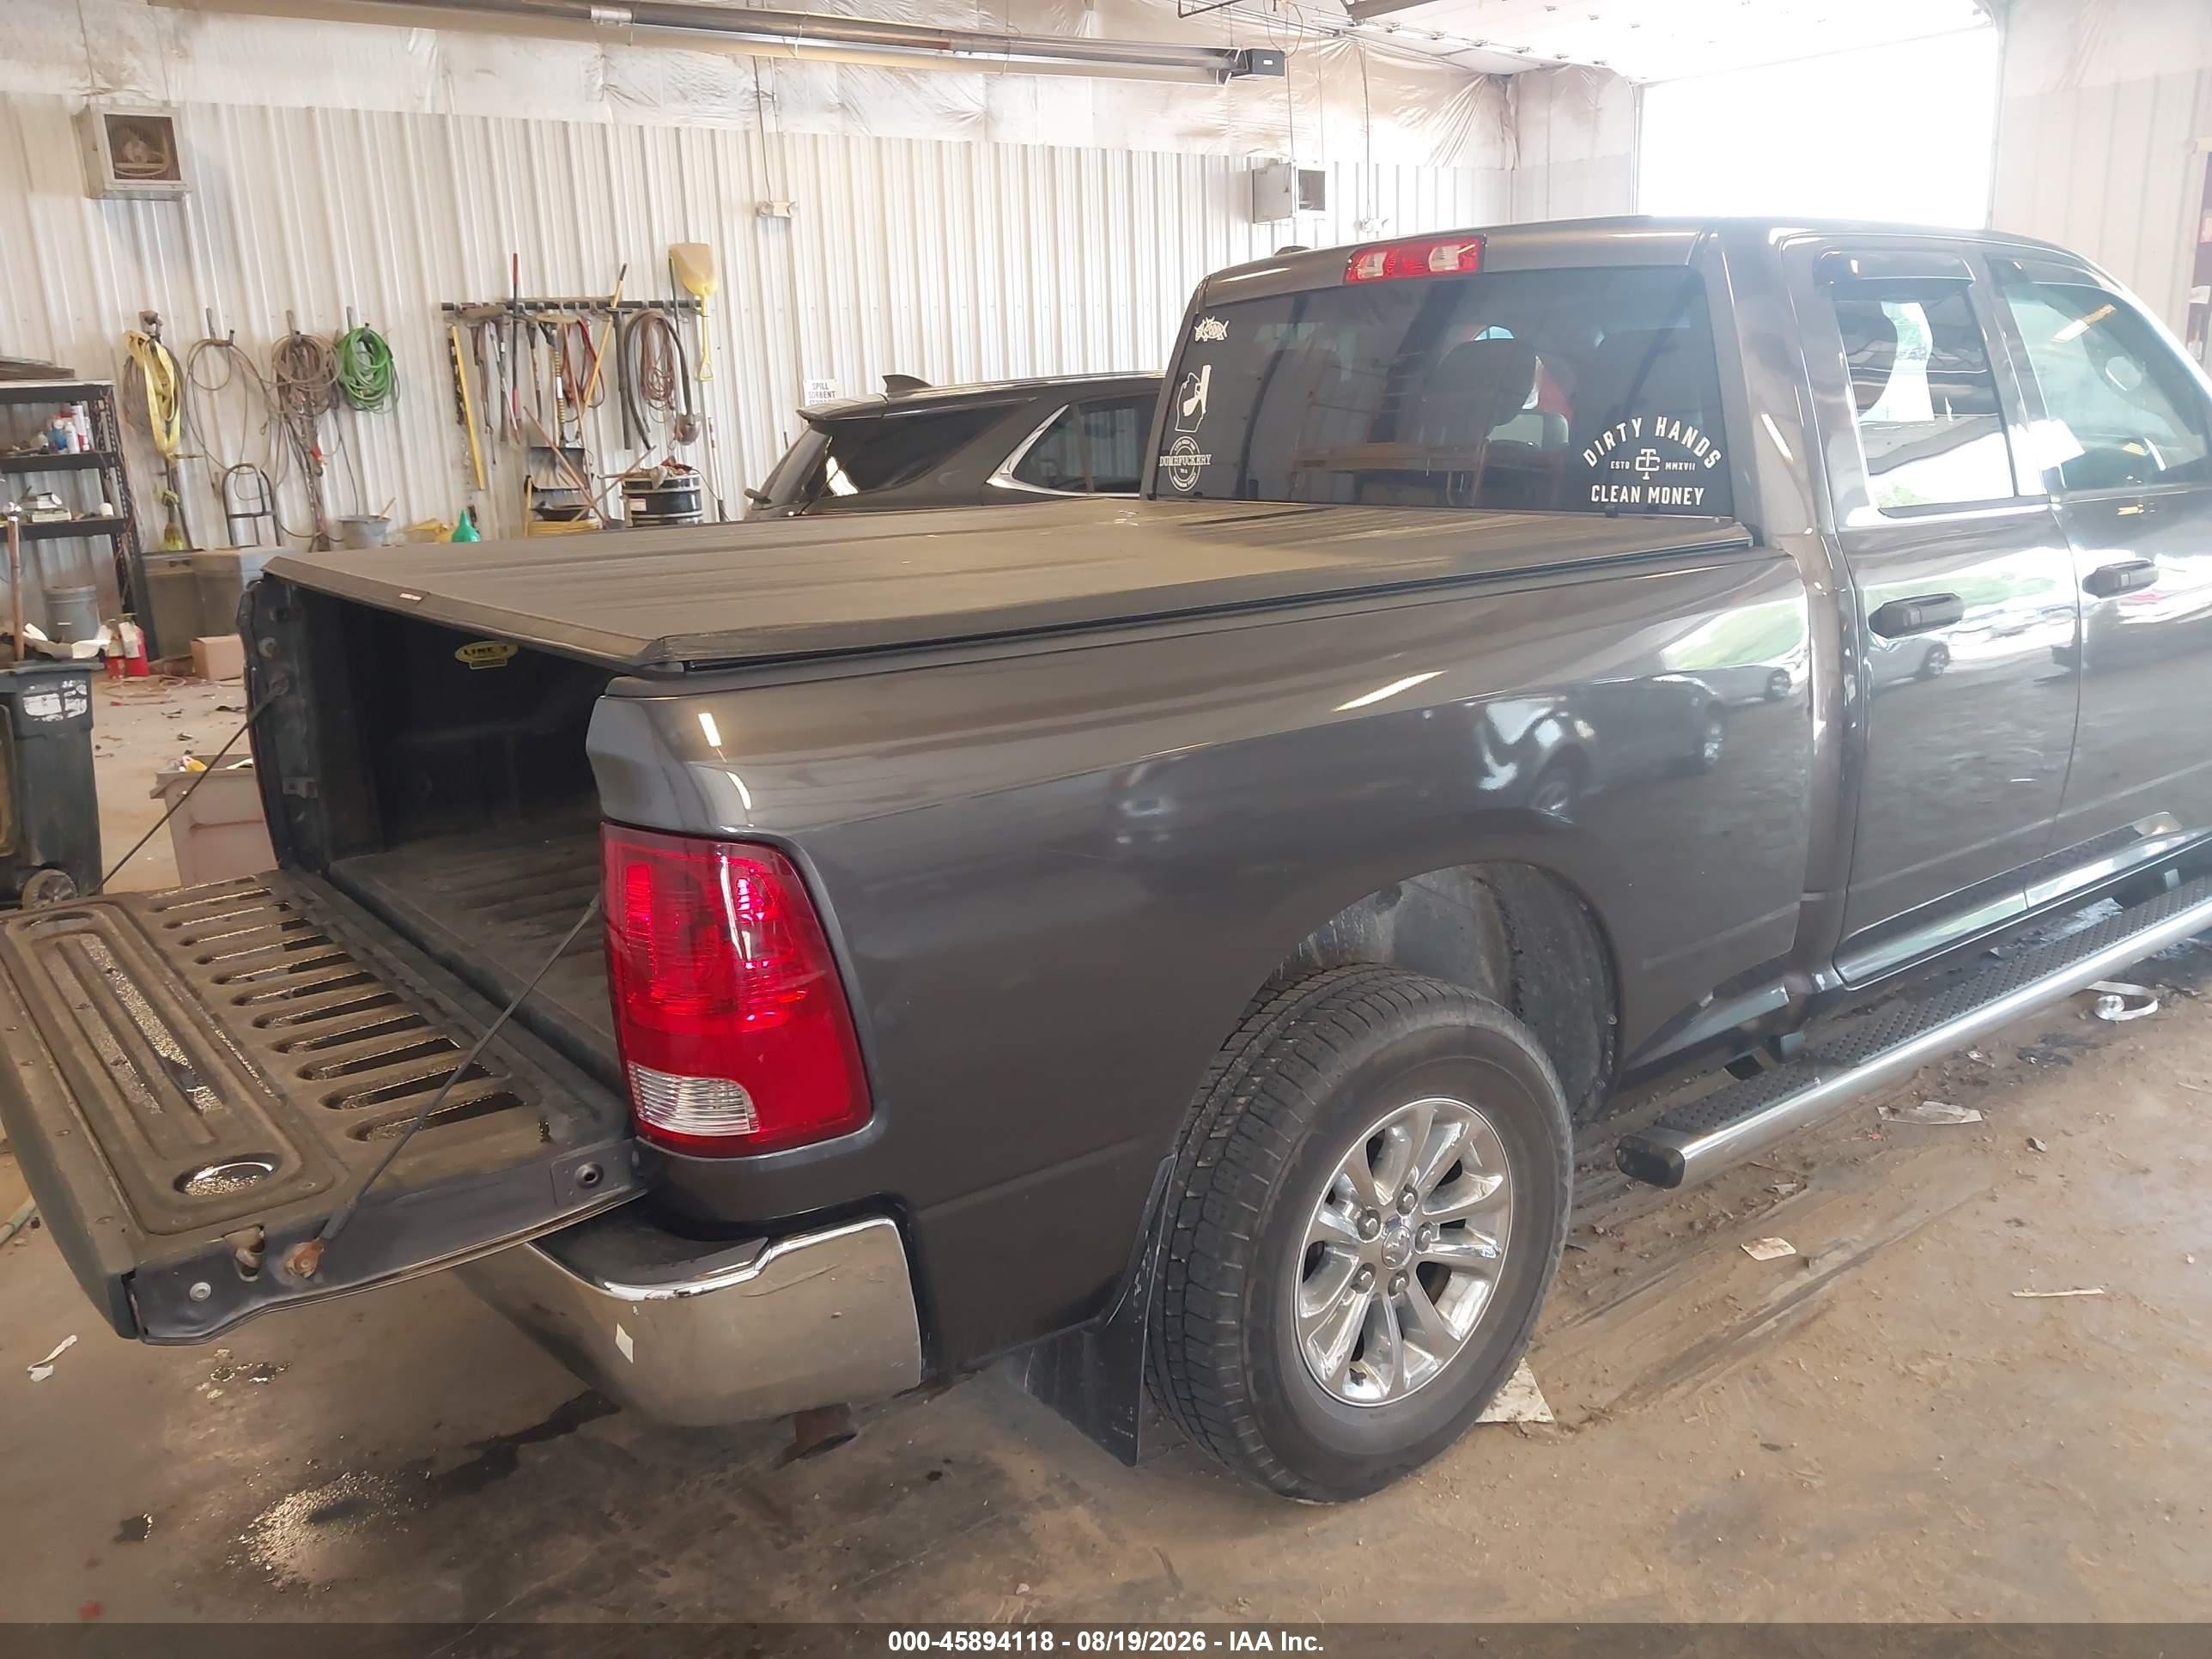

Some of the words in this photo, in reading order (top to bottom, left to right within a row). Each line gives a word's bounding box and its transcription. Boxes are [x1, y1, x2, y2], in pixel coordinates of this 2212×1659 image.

[1583, 417, 1643, 467] DIRTY
[1655, 416, 1722, 469] HANDS
[1159, 453, 1212, 466] DUMBFUCKERY
[1610, 460, 1630, 470] ESTD
[1665, 461, 1696, 471] MMXVII
[1590, 484, 1641, 503] CLEAN
[1647, 486, 1705, 506] MONEY
